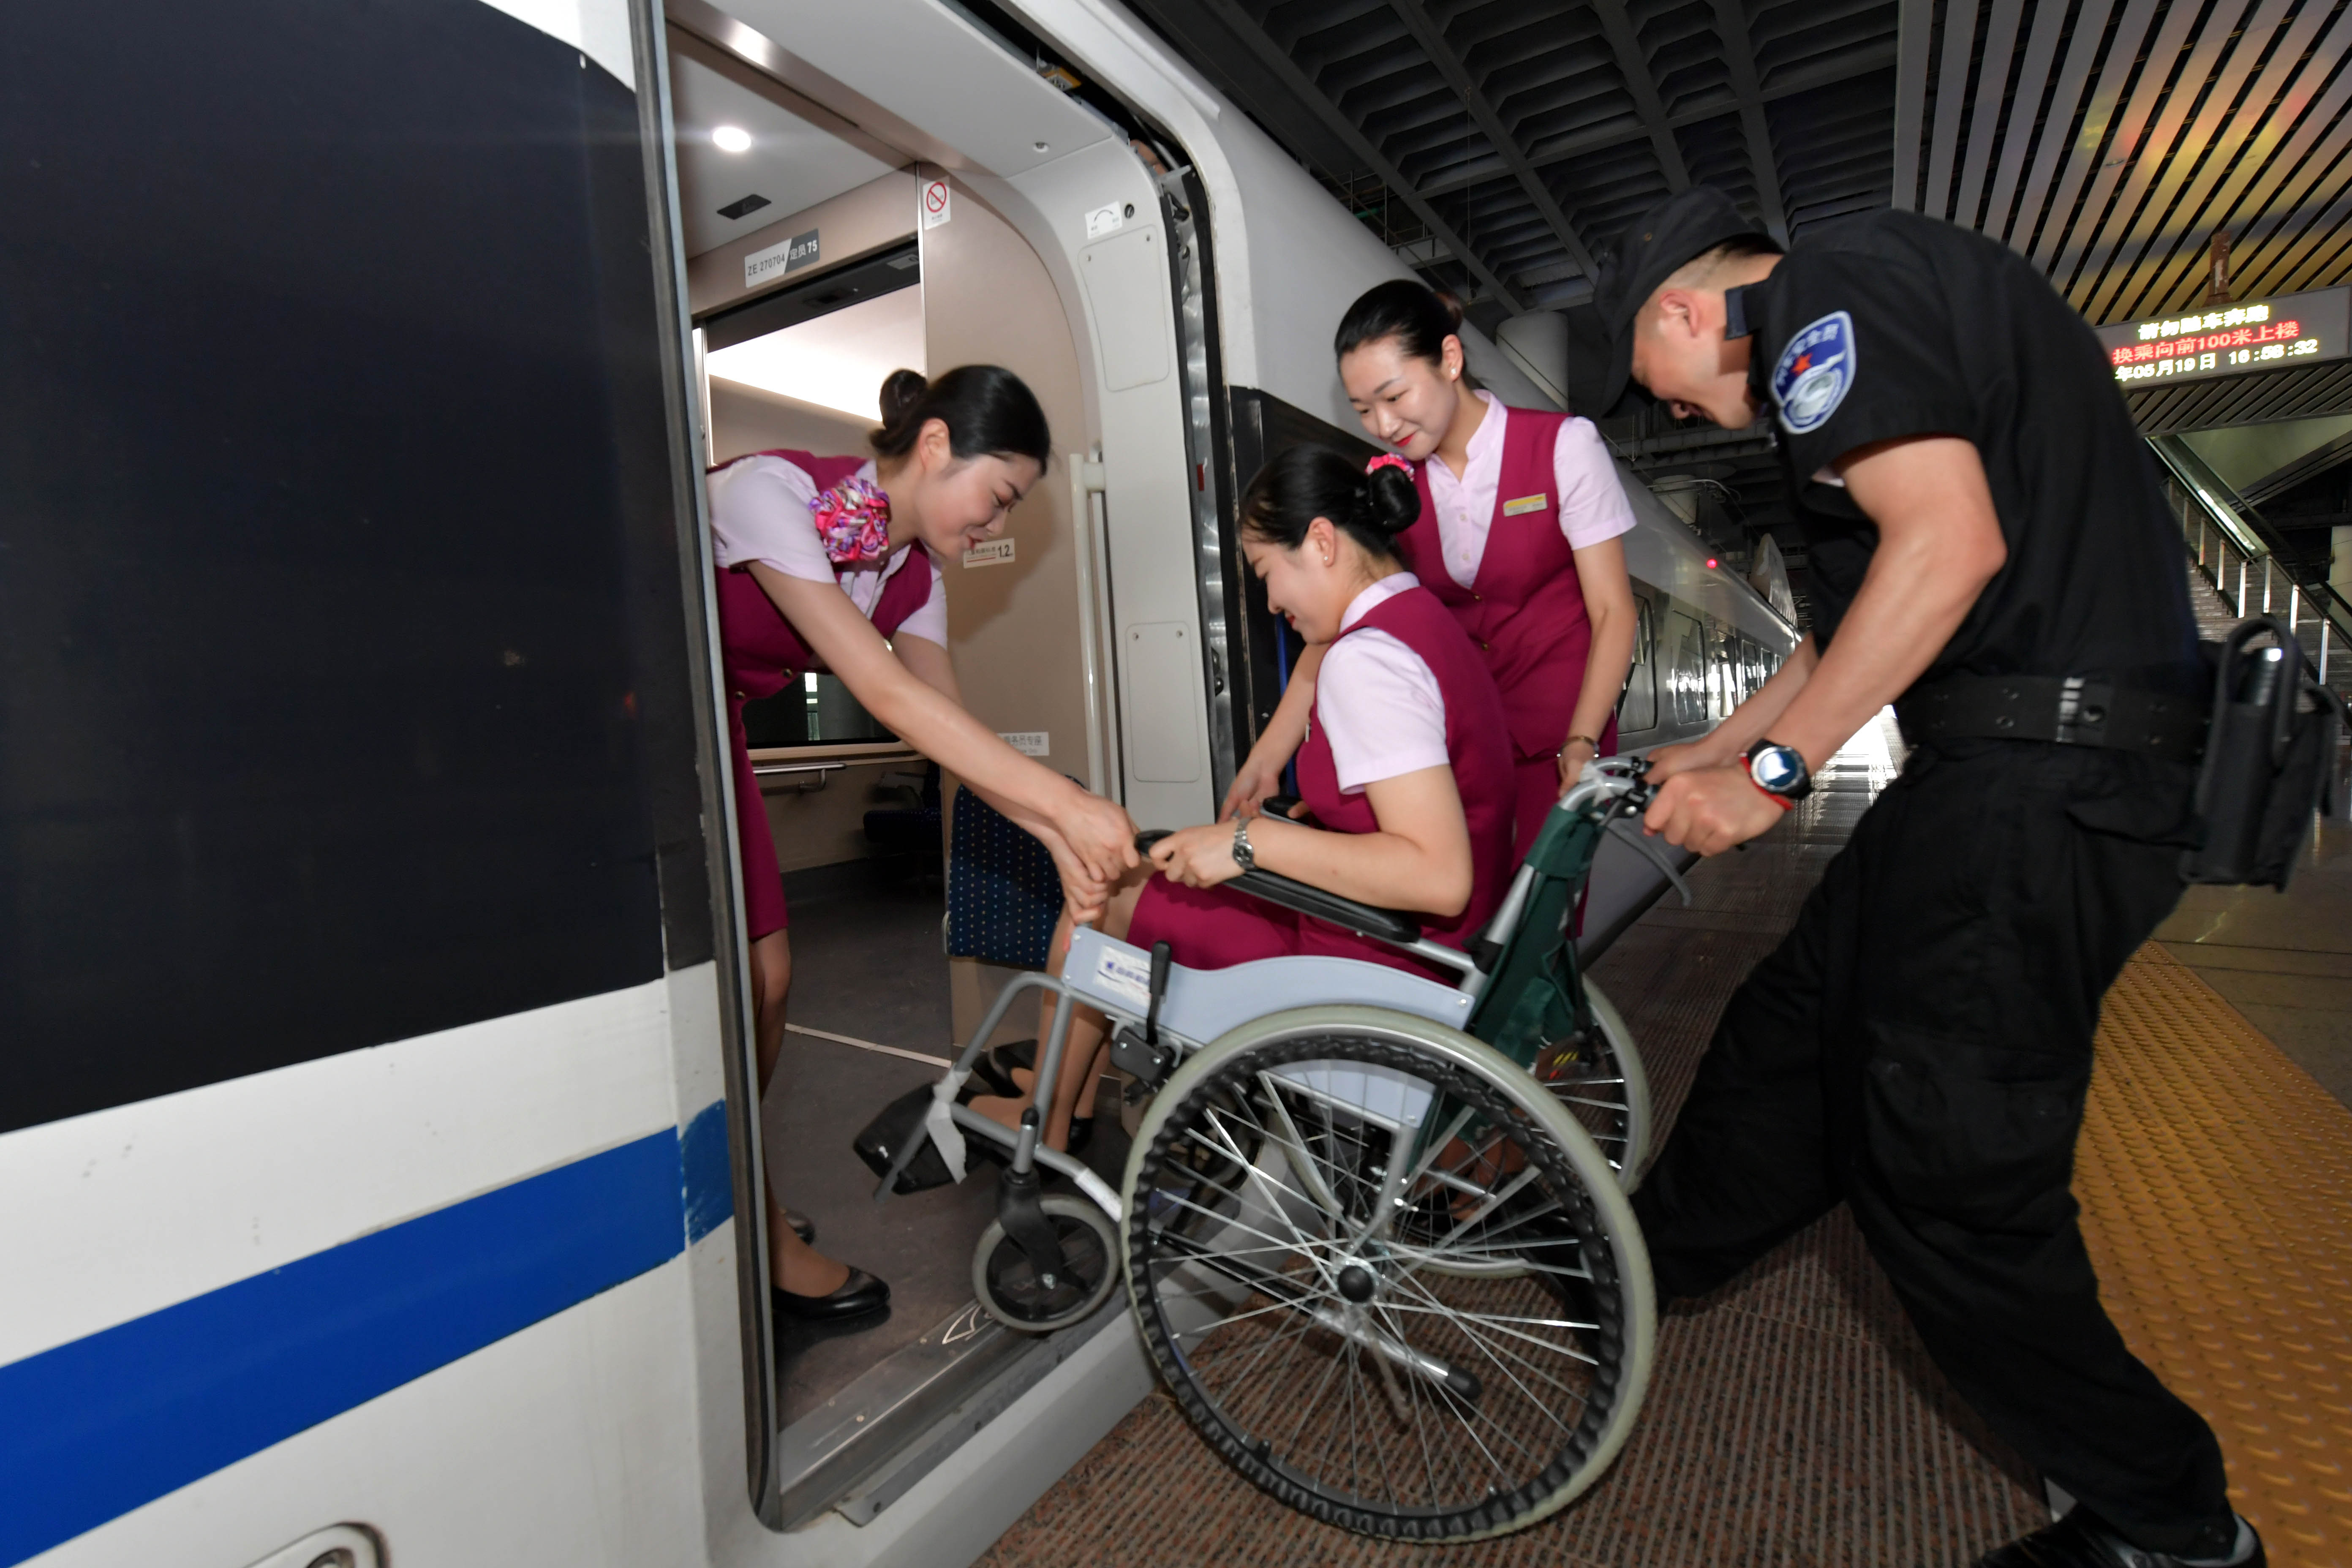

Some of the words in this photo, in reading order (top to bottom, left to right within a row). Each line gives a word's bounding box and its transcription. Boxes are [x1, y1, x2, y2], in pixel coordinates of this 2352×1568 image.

[748, 264, 757, 276] ZE
[760, 254, 785, 271] 270704
[789, 244, 806, 261] 定员
[807, 240, 818, 253] 75
[2138, 305, 2269, 340] 请勿随车奔跑
[2112, 320, 2300, 365] 换乘向前100米上楼
